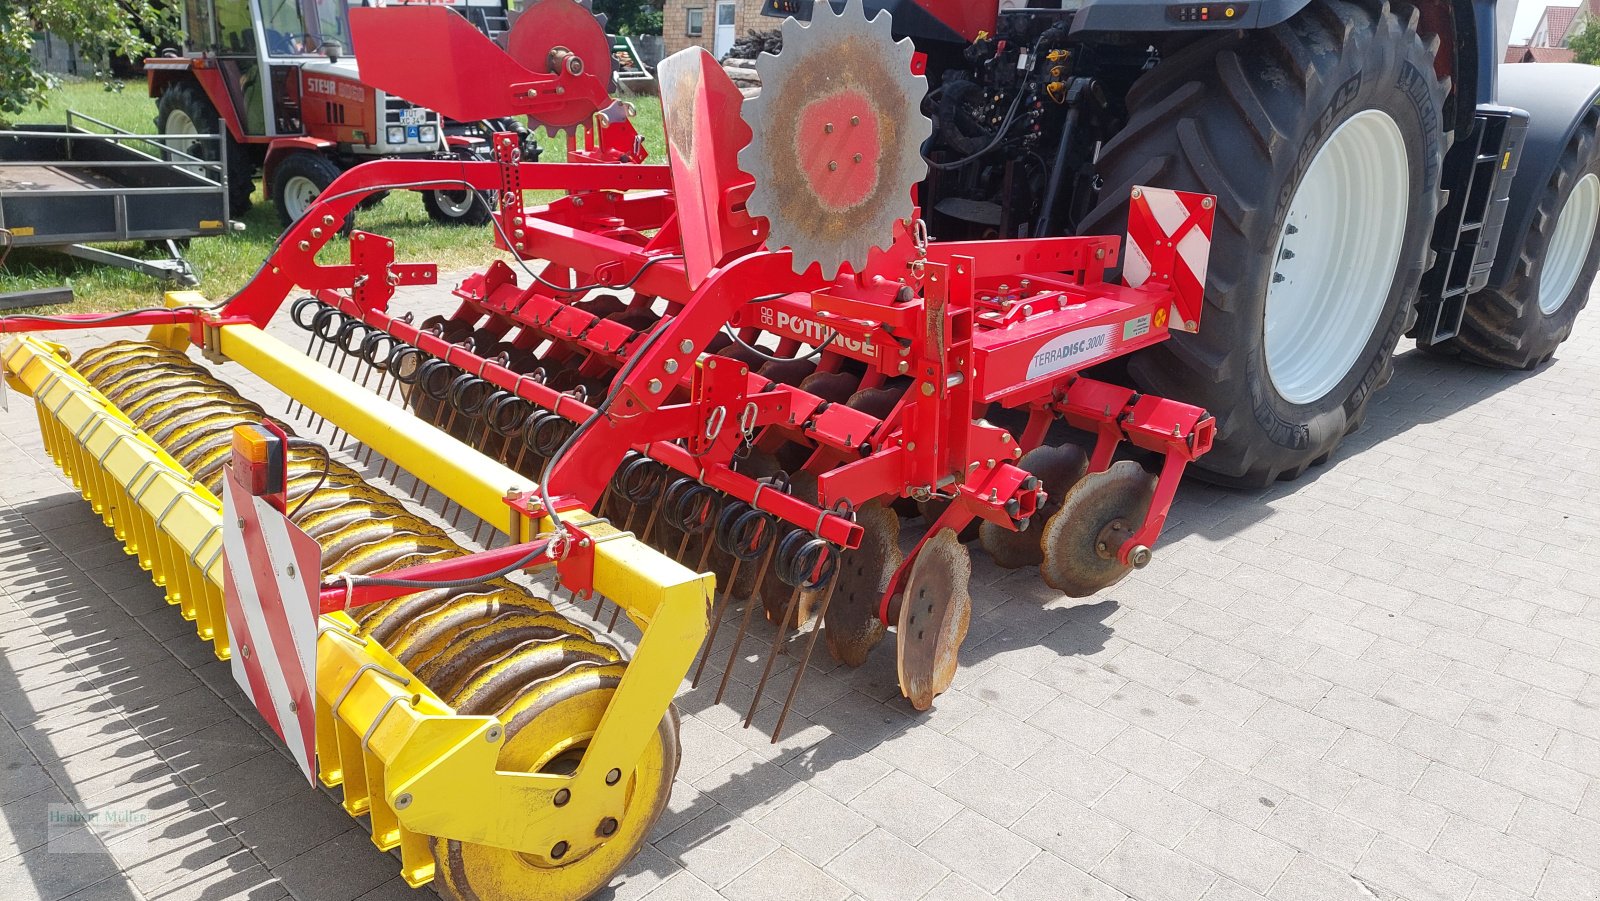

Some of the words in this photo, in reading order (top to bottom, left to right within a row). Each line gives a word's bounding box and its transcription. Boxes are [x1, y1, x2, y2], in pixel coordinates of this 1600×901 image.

[307, 77, 337, 96] STEYR
[1033, 339, 1087, 368] TERRADISC
[1085, 333, 1106, 352] 3000
